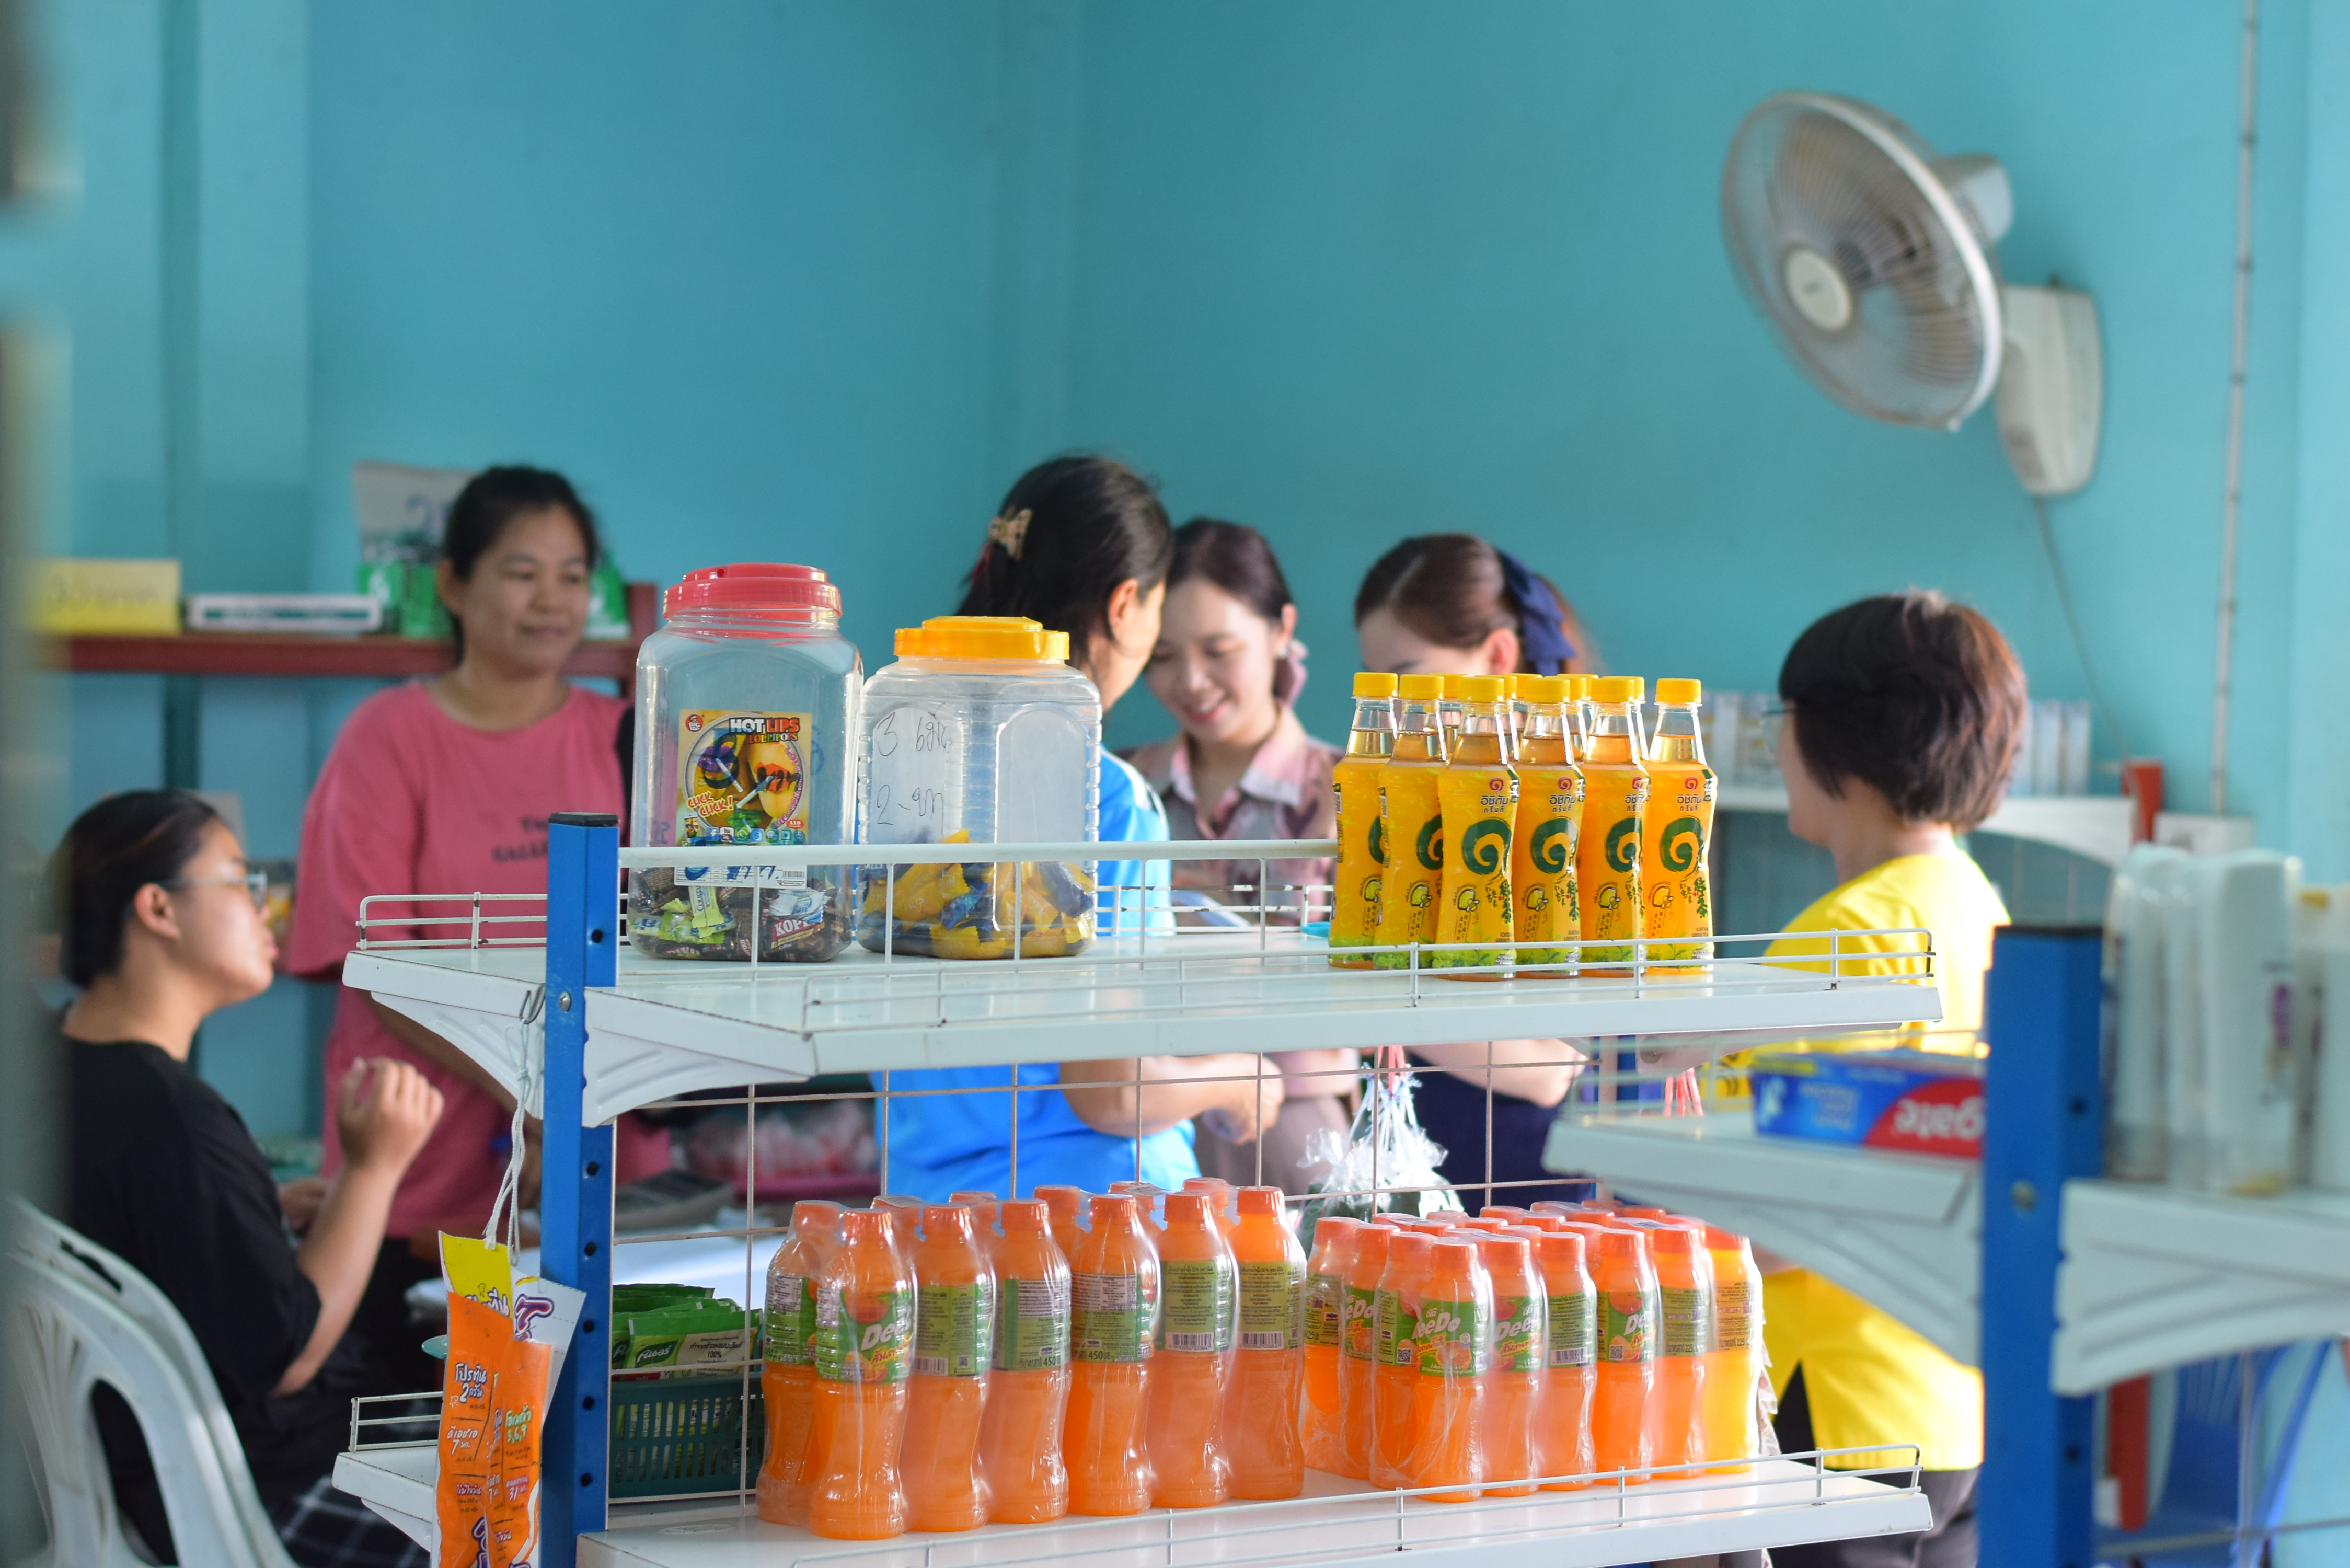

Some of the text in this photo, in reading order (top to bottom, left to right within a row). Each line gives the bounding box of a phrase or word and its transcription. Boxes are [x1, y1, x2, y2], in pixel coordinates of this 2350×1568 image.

[729, 717, 800, 733] HOT LIPS
[748, 732, 798, 744] LOLLIPOPS
[877, 712, 898, 757] 3
[687, 792, 713, 809] CLICK
[1480, 794, 1509, 805] อิชิตัน
[1677, 794, 1701, 804] อิชิตัน
[774, 919, 813, 937] KOP
[1894, 1097, 1986, 1141] gate
[1345, 1299, 1378, 1319] eDo
[1043, 1356, 1056, 1365] 450
[1088, 1351, 1103, 1359] 450
[455, 1362, 488, 1384] โปรตีน
[459, 1382, 469, 1403] 2
[447, 1425, 478, 1439] ดีเอชเอ
[452, 1439, 459, 1455] 7
